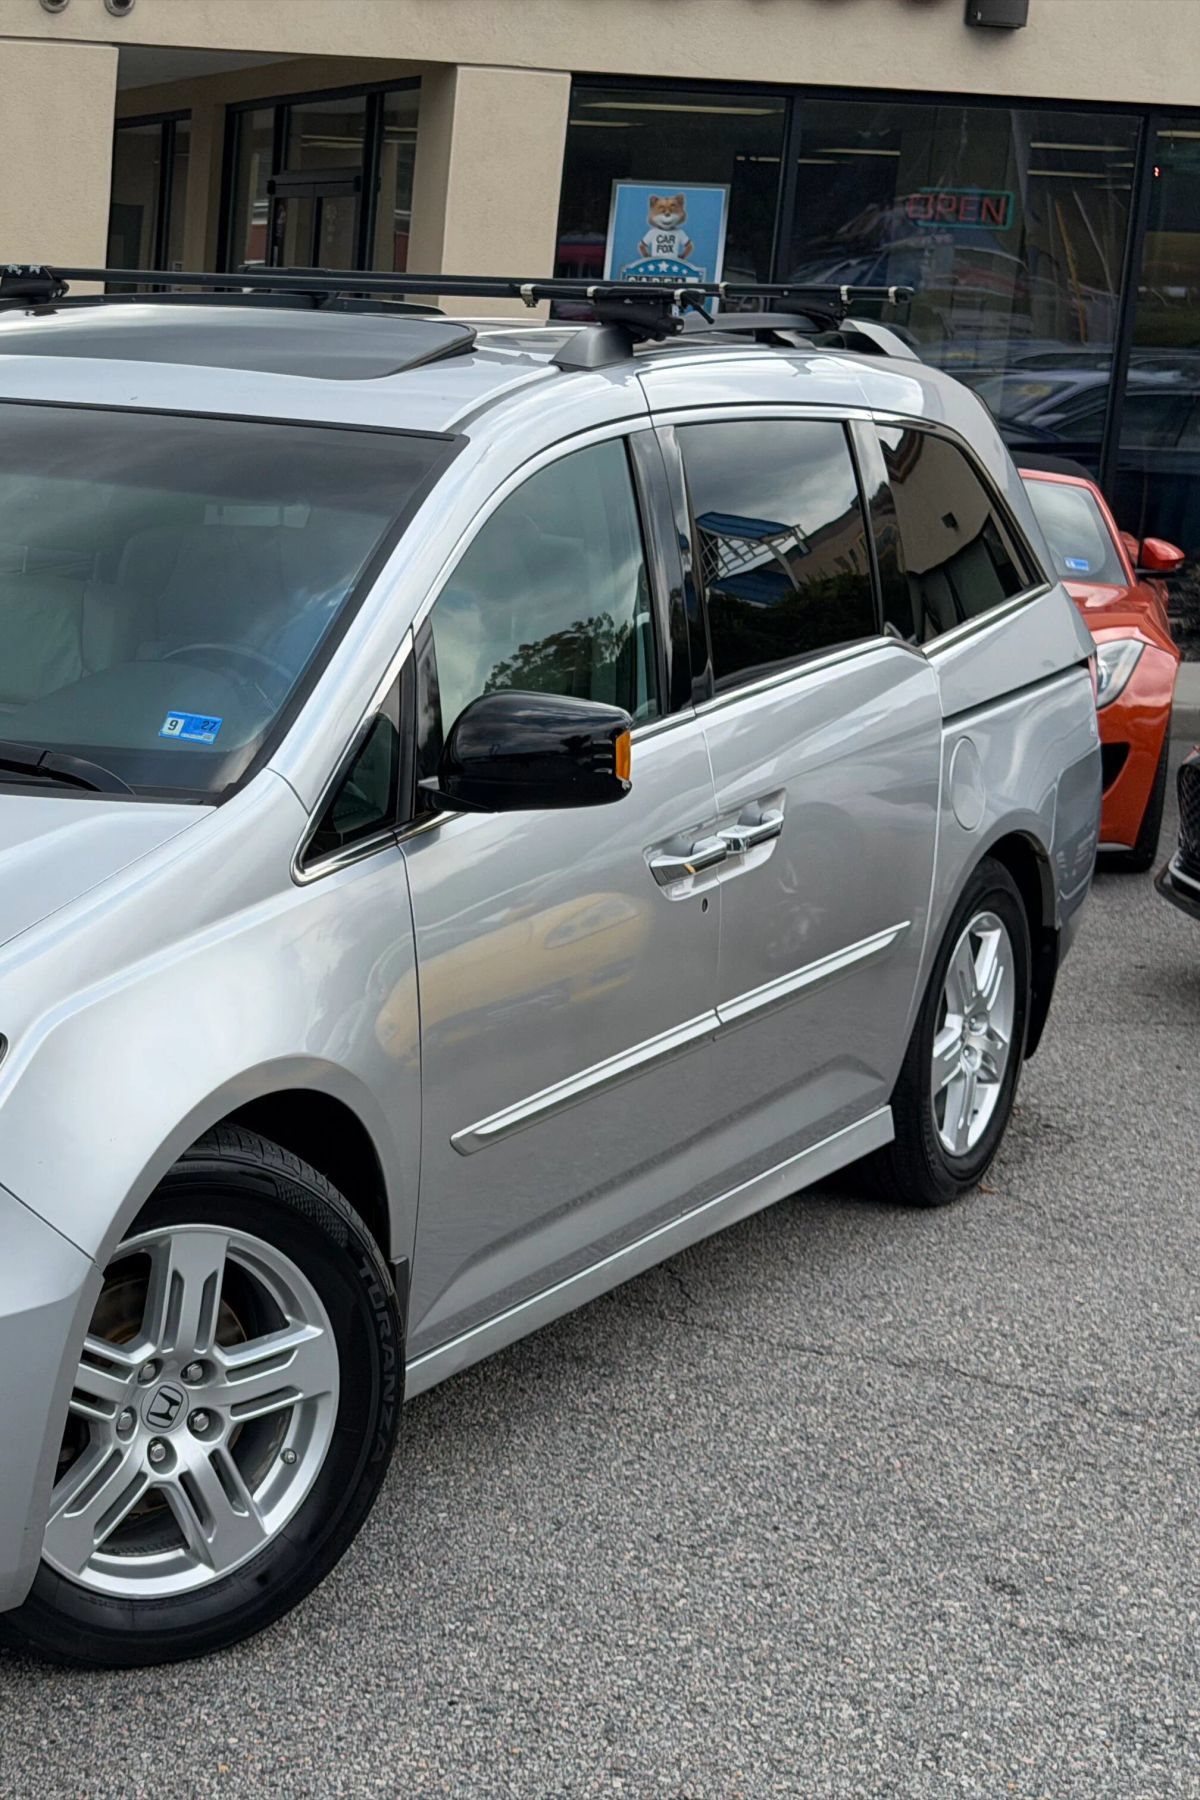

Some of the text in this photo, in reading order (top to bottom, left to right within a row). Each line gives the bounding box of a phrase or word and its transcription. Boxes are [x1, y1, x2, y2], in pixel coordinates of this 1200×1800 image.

[908, 193, 1006, 225] OPEN
[656, 234, 675, 244] CAR
[656, 244, 674, 253] FOX
[167, 719, 218, 731] 9 27
[359, 1255, 397, 1463] TURANZA
